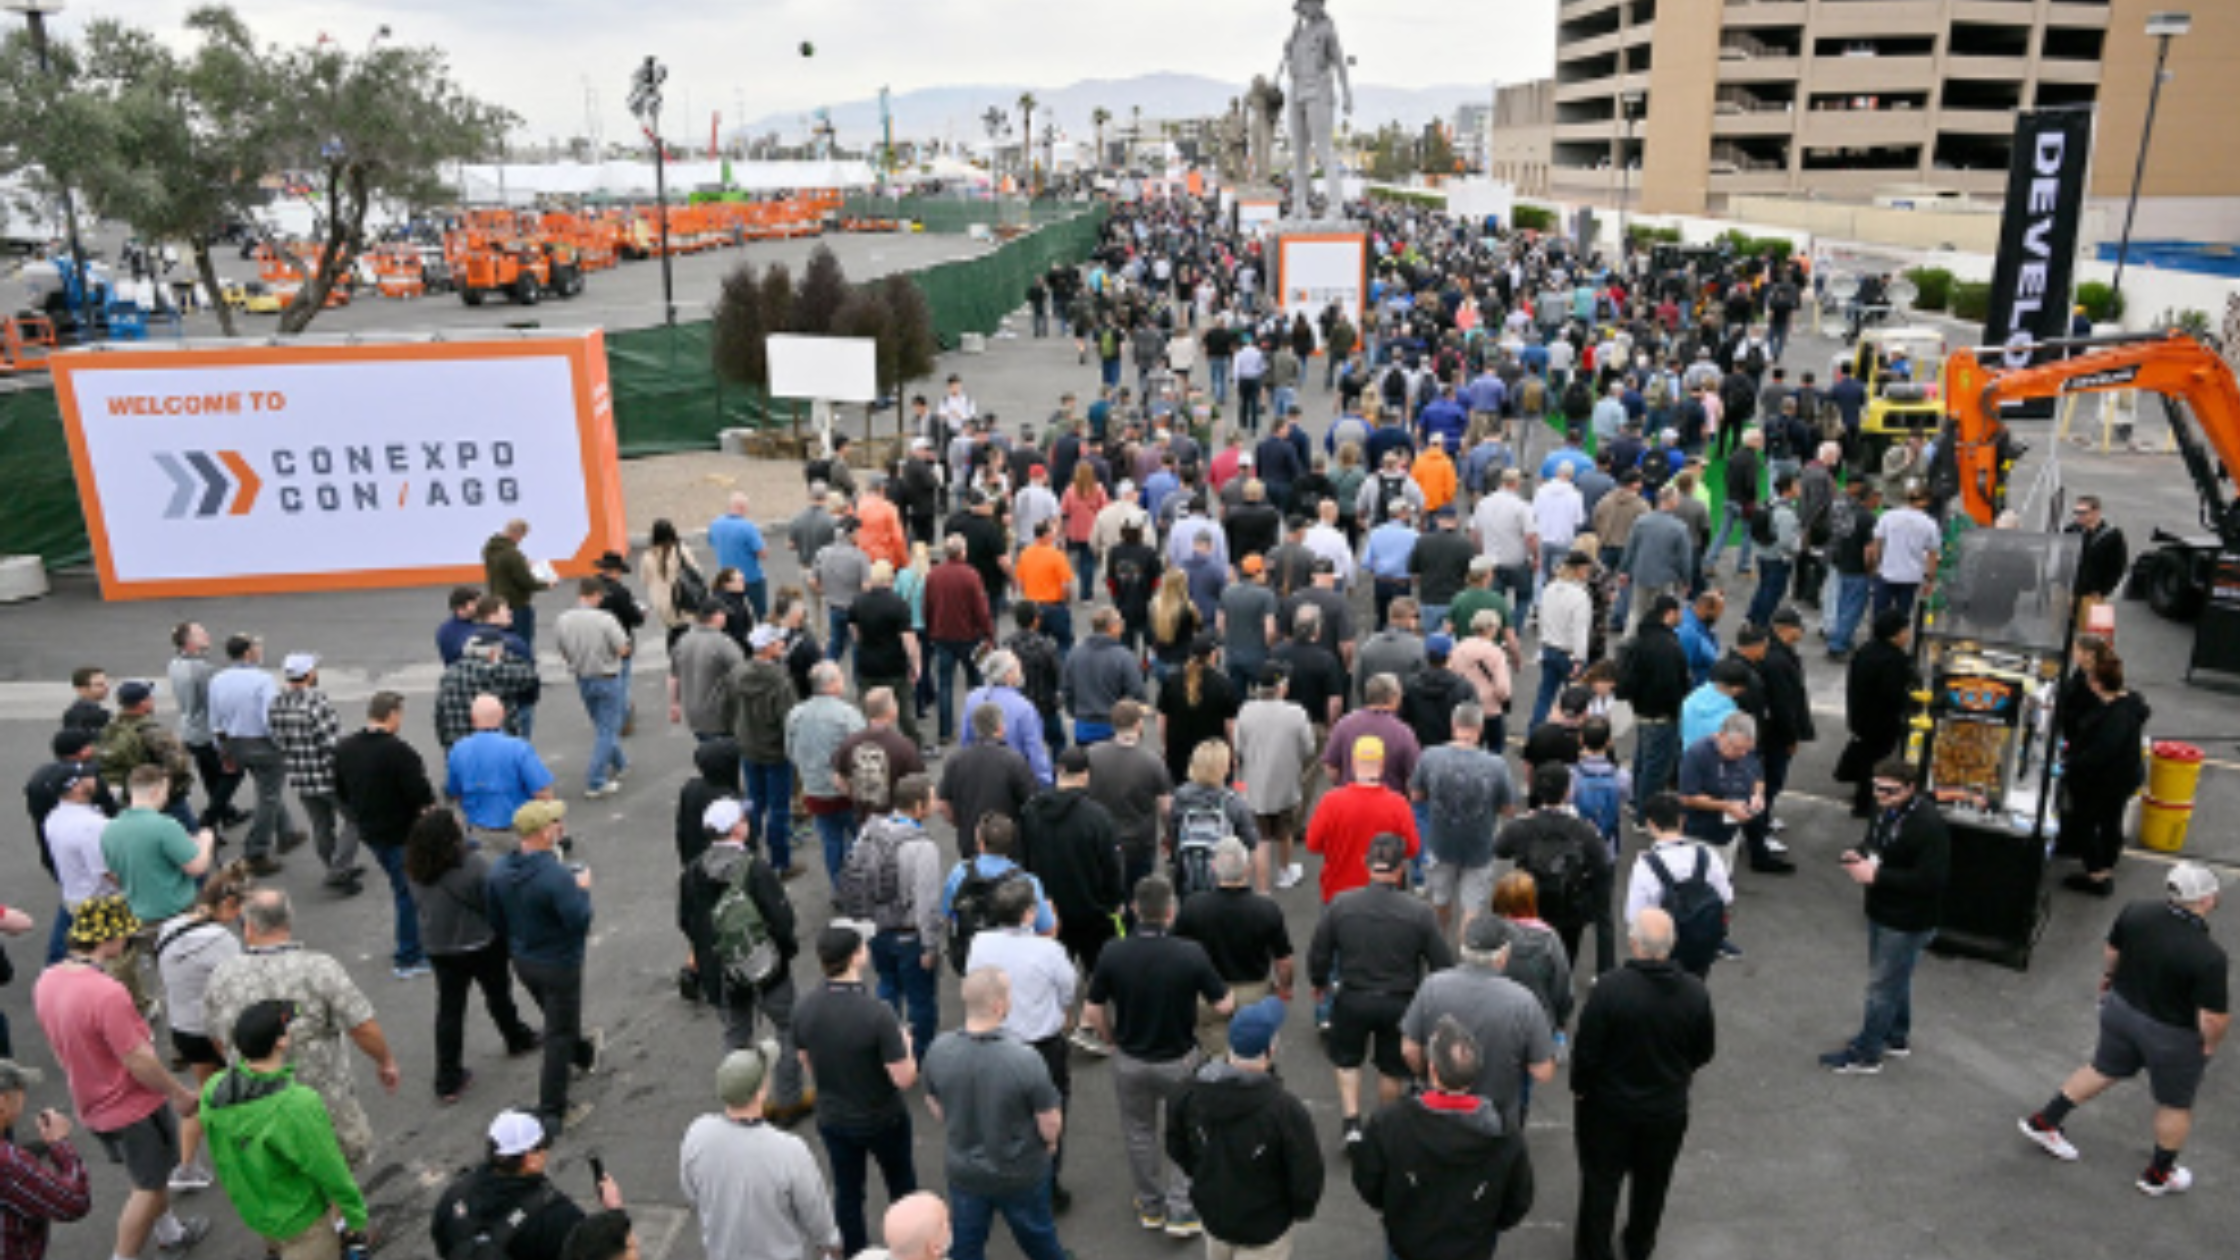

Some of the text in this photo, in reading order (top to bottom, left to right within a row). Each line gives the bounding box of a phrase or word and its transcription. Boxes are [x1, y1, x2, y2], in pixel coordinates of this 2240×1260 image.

[1998, 131, 2066, 408] DEVELO
[106, 391, 287, 416] WELCOME TO
[272, 441, 515, 476] CONEXPO
[279, 481, 380, 513] CON
[426, 476, 519, 507] AGG
